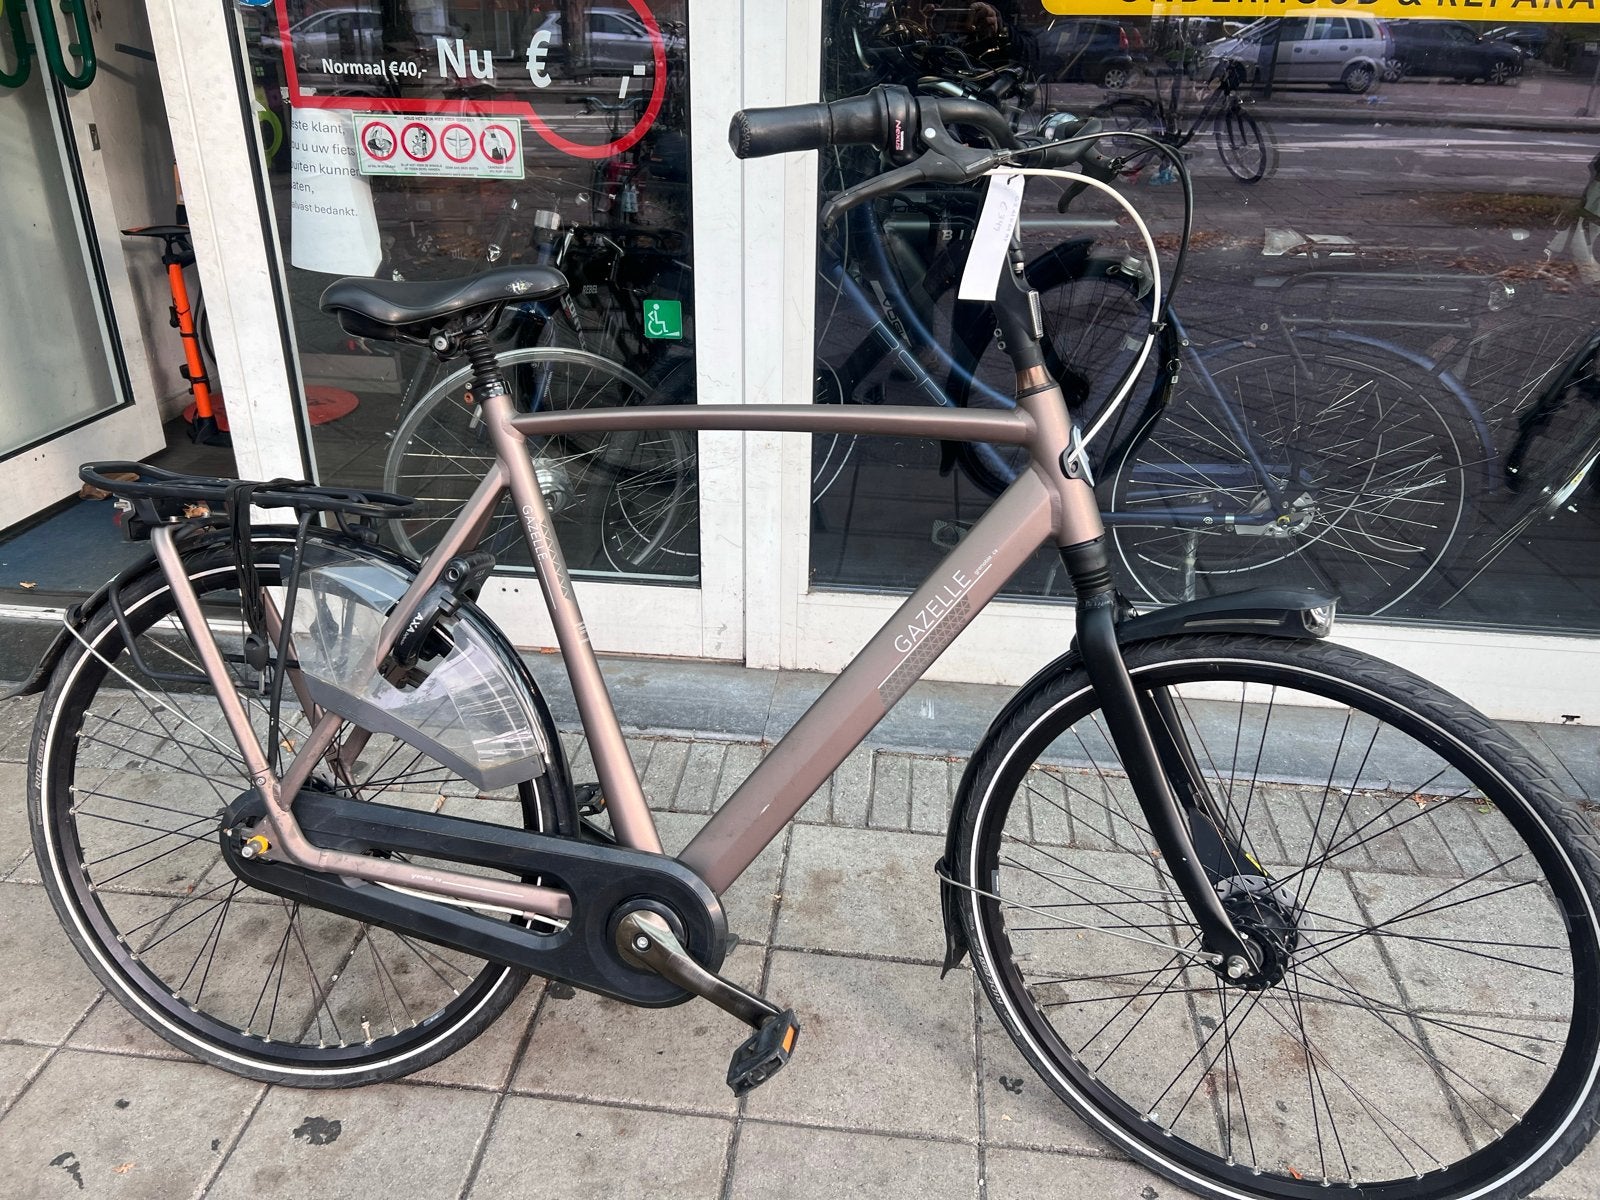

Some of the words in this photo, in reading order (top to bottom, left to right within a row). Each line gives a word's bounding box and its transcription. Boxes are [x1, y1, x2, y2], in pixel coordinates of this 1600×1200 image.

[321, 58, 387, 76] Normaal
[388, 61, 428, 79] €40,-
[435, 38, 494, 79] Nu
[311, 121, 346, 135] klant,
[301, 143, 308, 152] u
[311, 144, 329, 154] uw
[332, 143, 356, 156] fiets
[314, 204, 358, 217] bedankt.
[942, 229, 977, 240] BI
[522, 504, 549, 562] GAZELLE
[894, 569, 972, 653] GAZELLE
[406, 611, 424, 633] AXA
